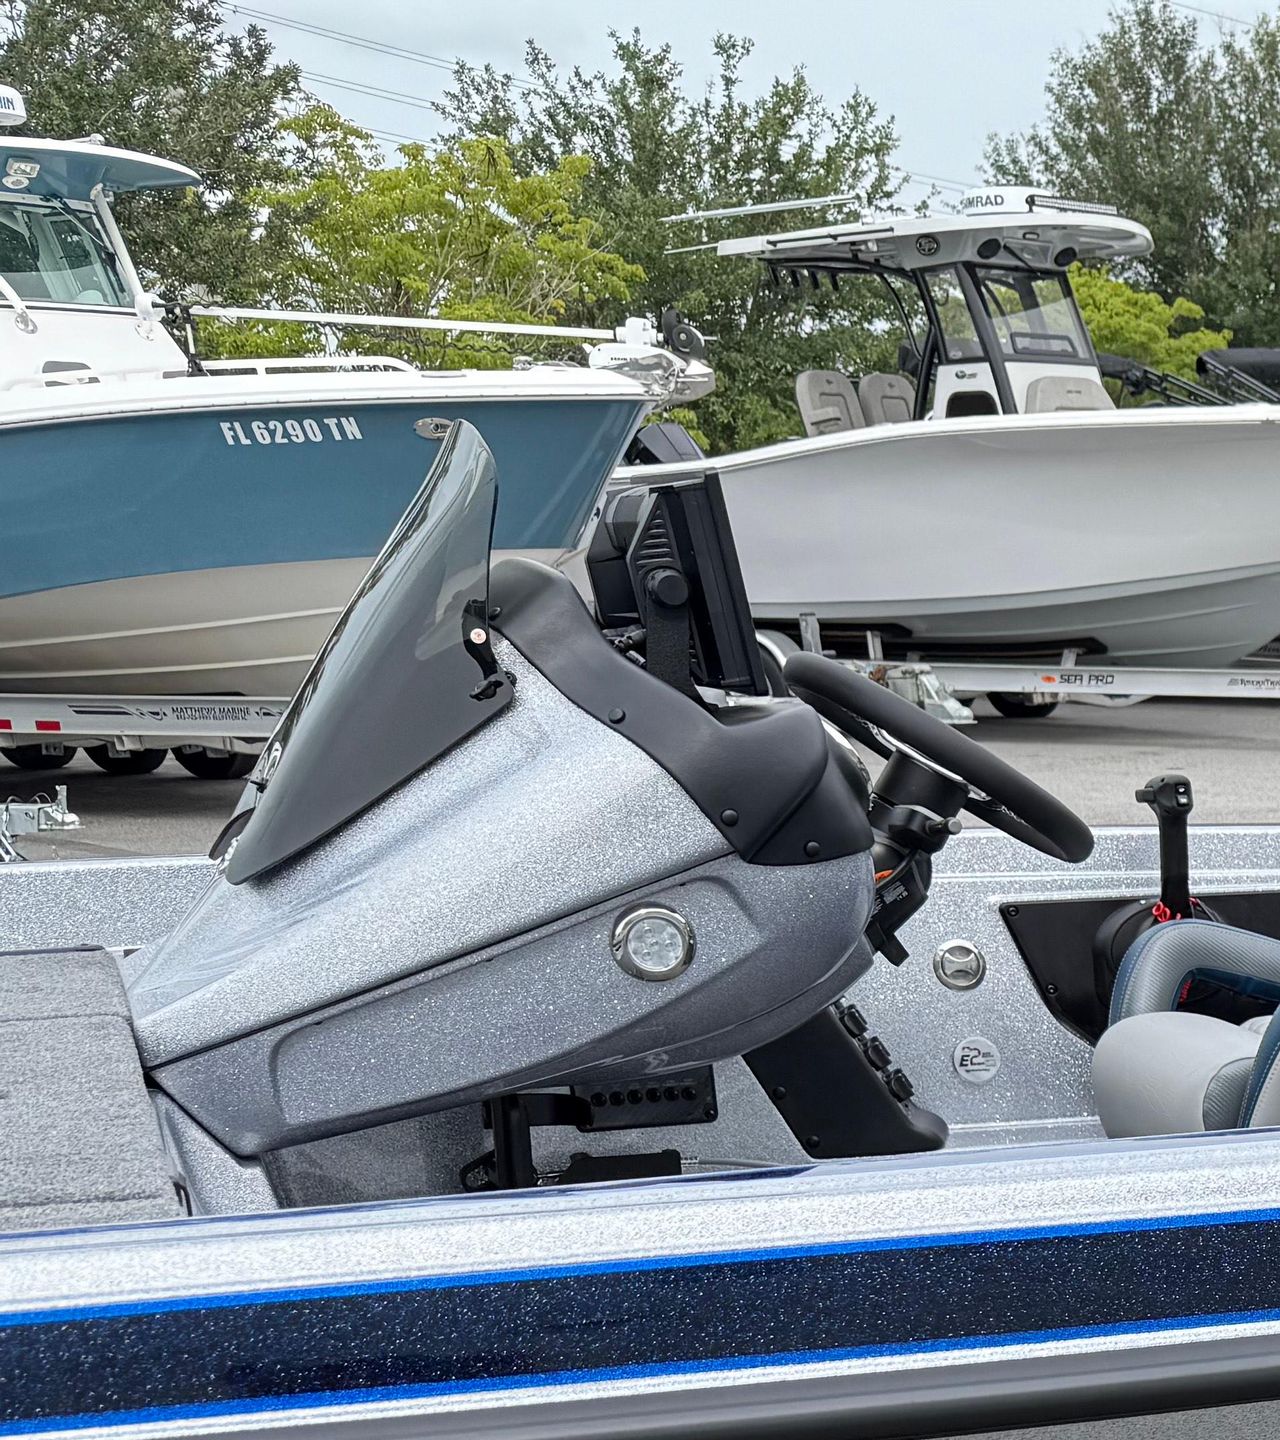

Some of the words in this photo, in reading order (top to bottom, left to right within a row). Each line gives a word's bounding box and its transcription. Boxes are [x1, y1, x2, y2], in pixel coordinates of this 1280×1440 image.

[219, 421, 252, 446] FL
[251, 418, 323, 445] 6290
[323, 416, 363, 441] TN
[1059, 674, 1083, 685] SEA
[1088, 674, 1115, 686] PRO
